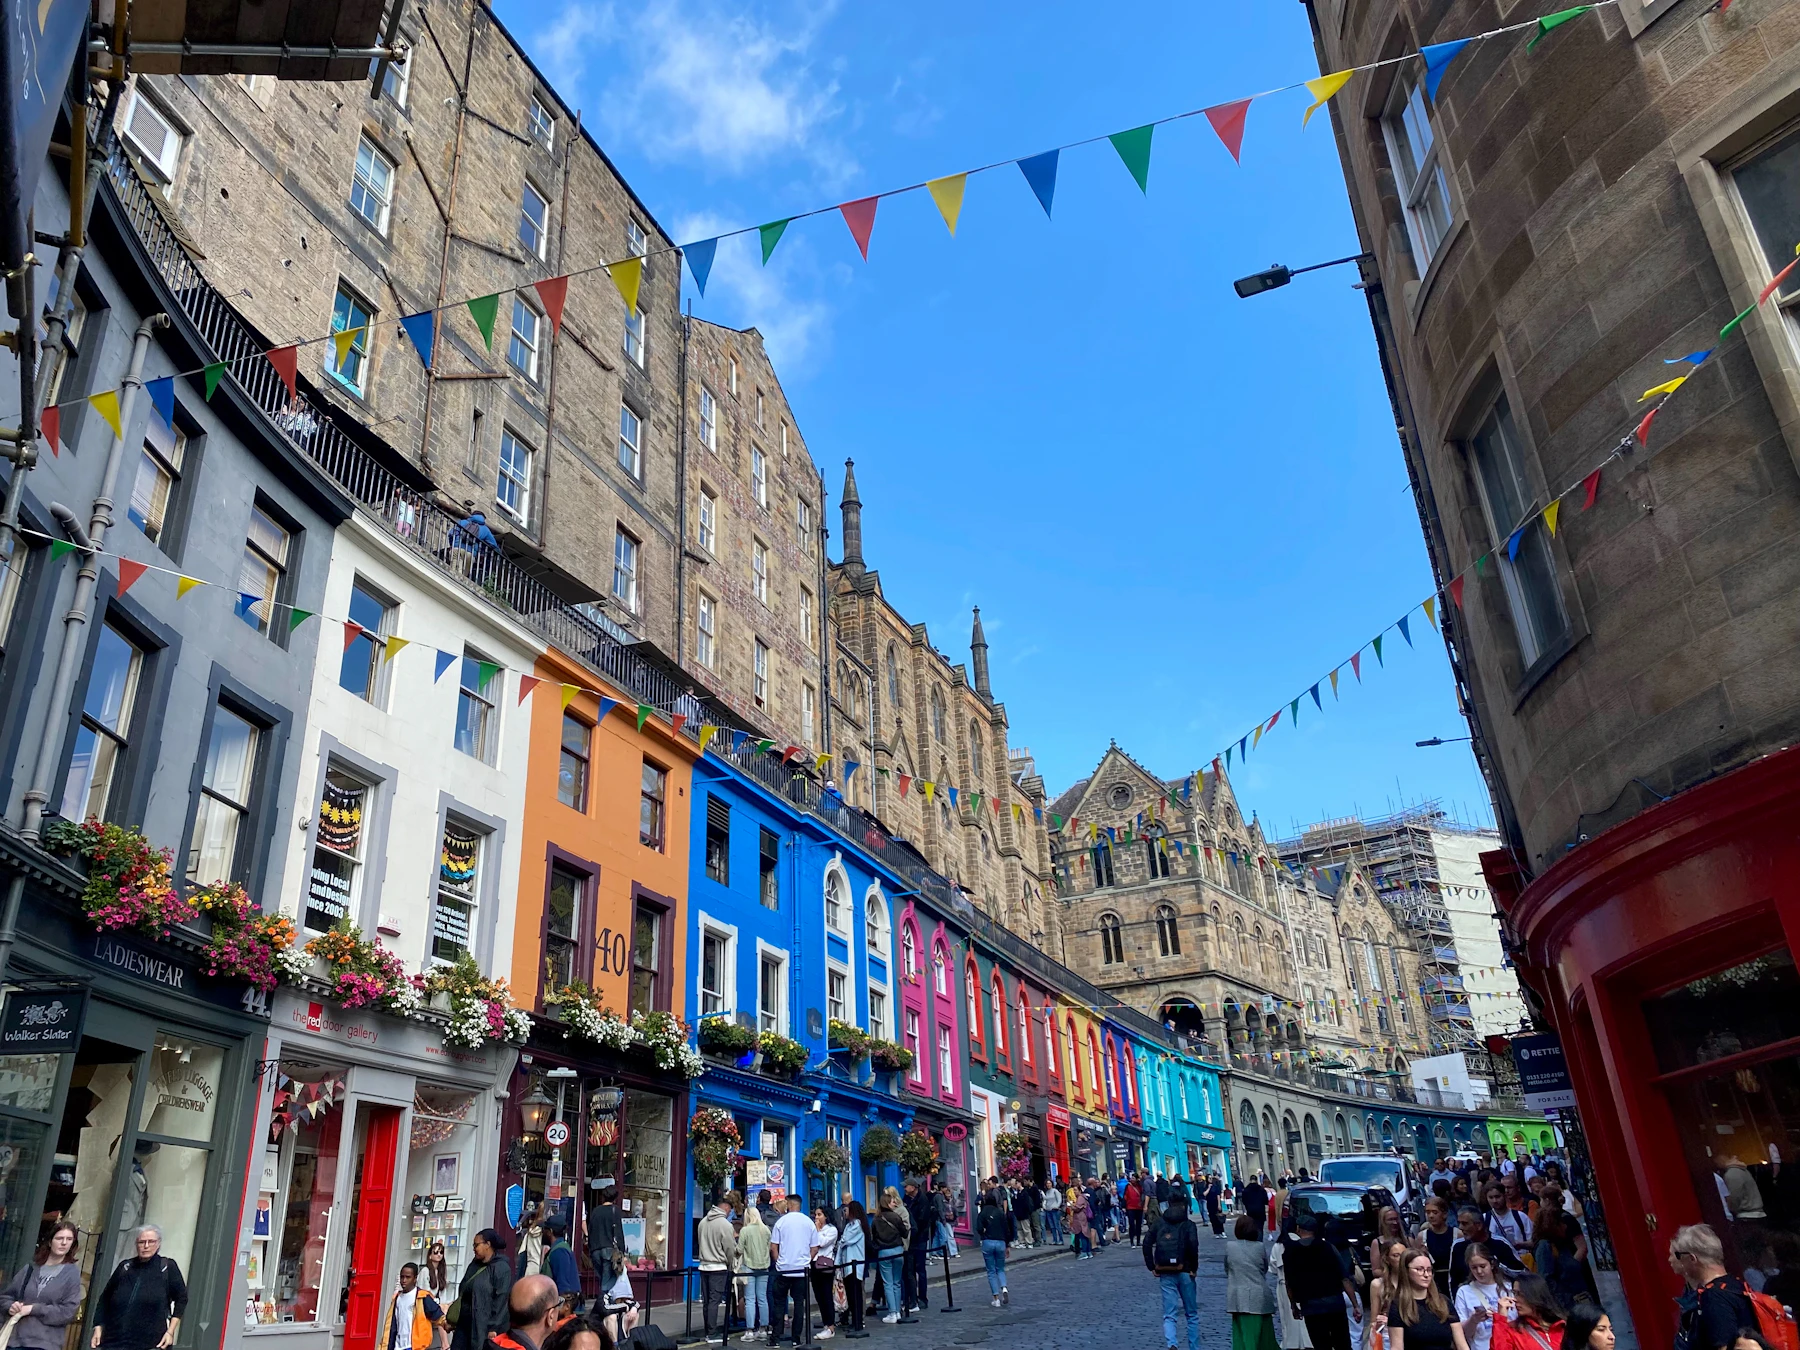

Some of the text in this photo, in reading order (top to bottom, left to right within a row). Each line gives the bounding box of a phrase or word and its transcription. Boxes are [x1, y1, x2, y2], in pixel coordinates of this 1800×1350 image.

[311, 883, 326, 897] and
[330, 873, 350, 891] Local
[307, 895, 344, 919] ince 2003
[596, 927, 626, 976] 40
[94, 937, 184, 988] LADIESWEAR
[5, 1029, 72, 1041] Walker Slater
[292, 1008, 378, 1043] the red door gallery
[1531, 1047, 1561, 1057] RETTIE
[184, 1069, 214, 1103] LUGGAGE
[549, 1129, 567, 1139] 20
